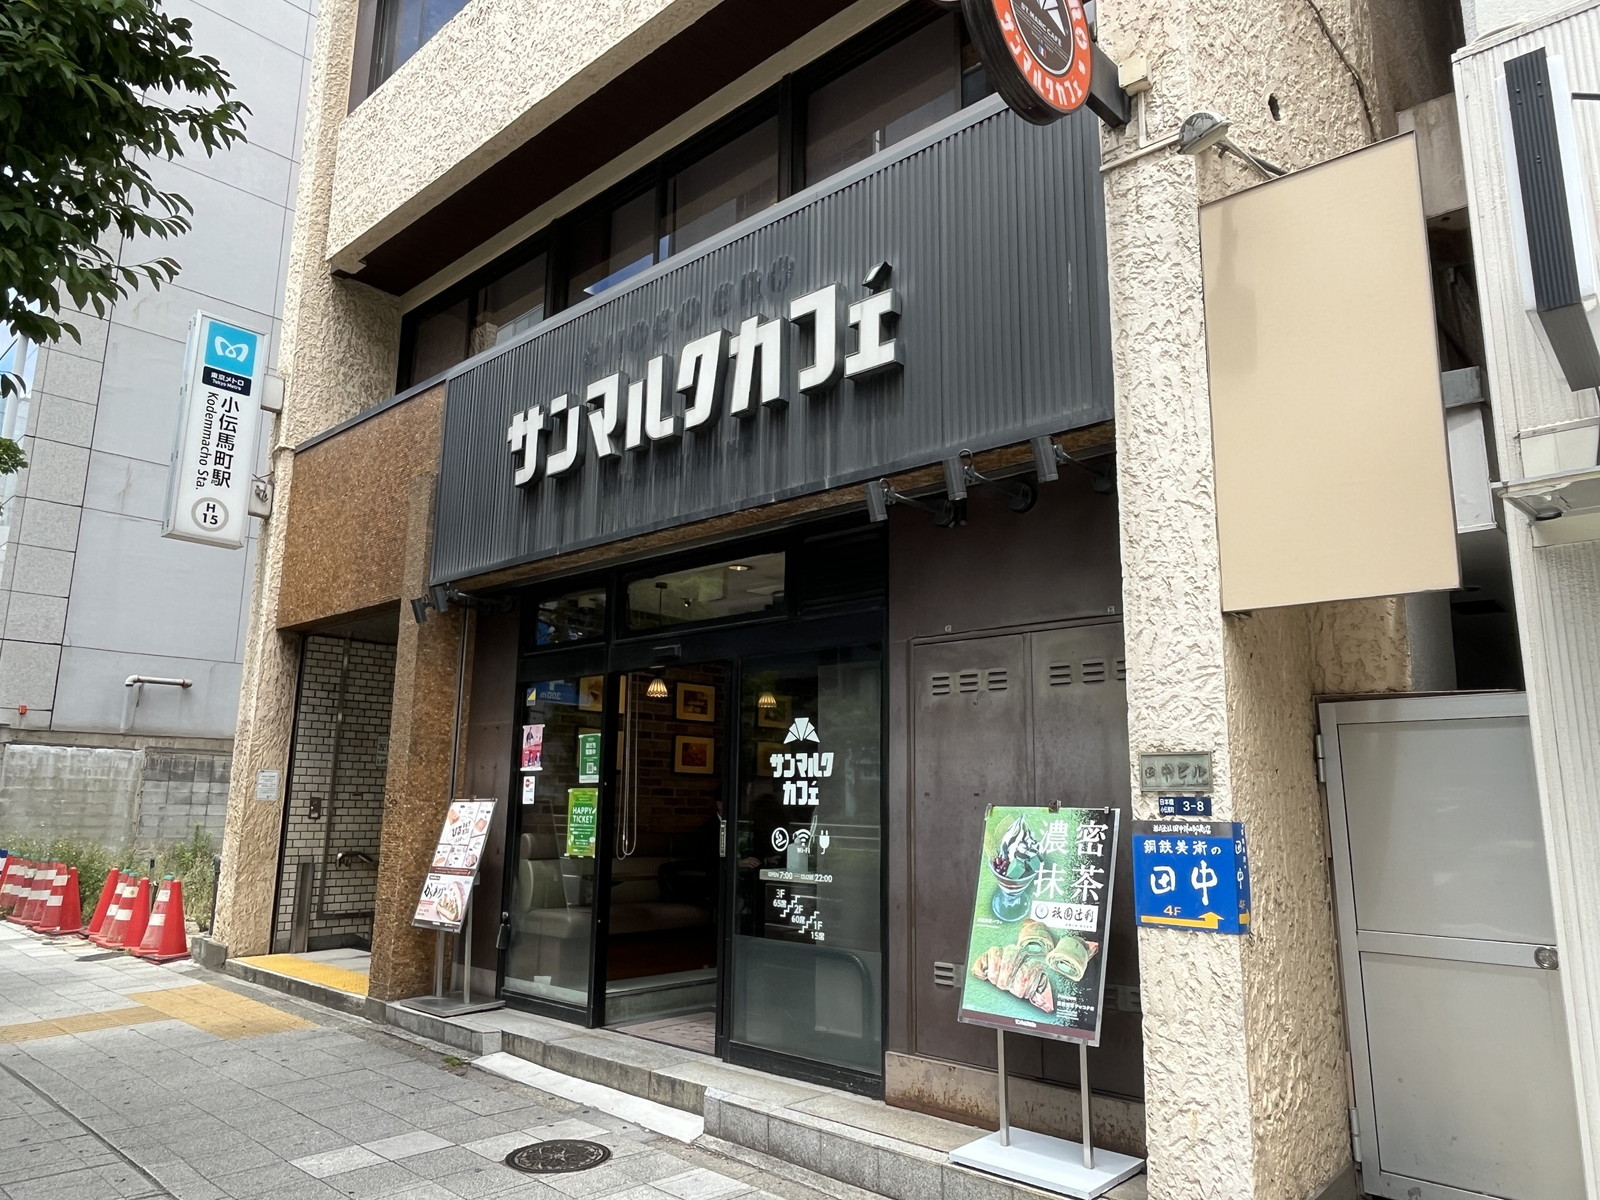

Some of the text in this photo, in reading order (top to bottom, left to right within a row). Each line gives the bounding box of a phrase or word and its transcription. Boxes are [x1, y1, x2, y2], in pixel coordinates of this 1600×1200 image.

[211, 372, 244, 387] 東京メトロ
[507, 262, 905, 489] サンマルクカフェ
[212, 378, 227, 387] Tokyo
[195, 392, 219, 490] Kodemmacho Sta.
[211, 397, 240, 488] 小伝馬町駅
[206, 503, 216, 513] H
[202, 512, 218, 525] 15
[770, 752, 834, 778] サンマルク
[783, 781, 819, 805] カフェ
[572, 806, 593, 815] HAPPY
[1182, 801, 1204, 812] 3-8
[572, 815, 594, 824] TICKET
[779, 872, 793, 880] 7:00
[814, 874, 833, 883] 22:00
[1150, 859, 1218, 906] 田中
[776, 889, 785, 898] 3F
[794, 905, 803, 914] 2F
[1163, 905, 1182, 916] 4F
[813, 921, 823, 930] 1F
